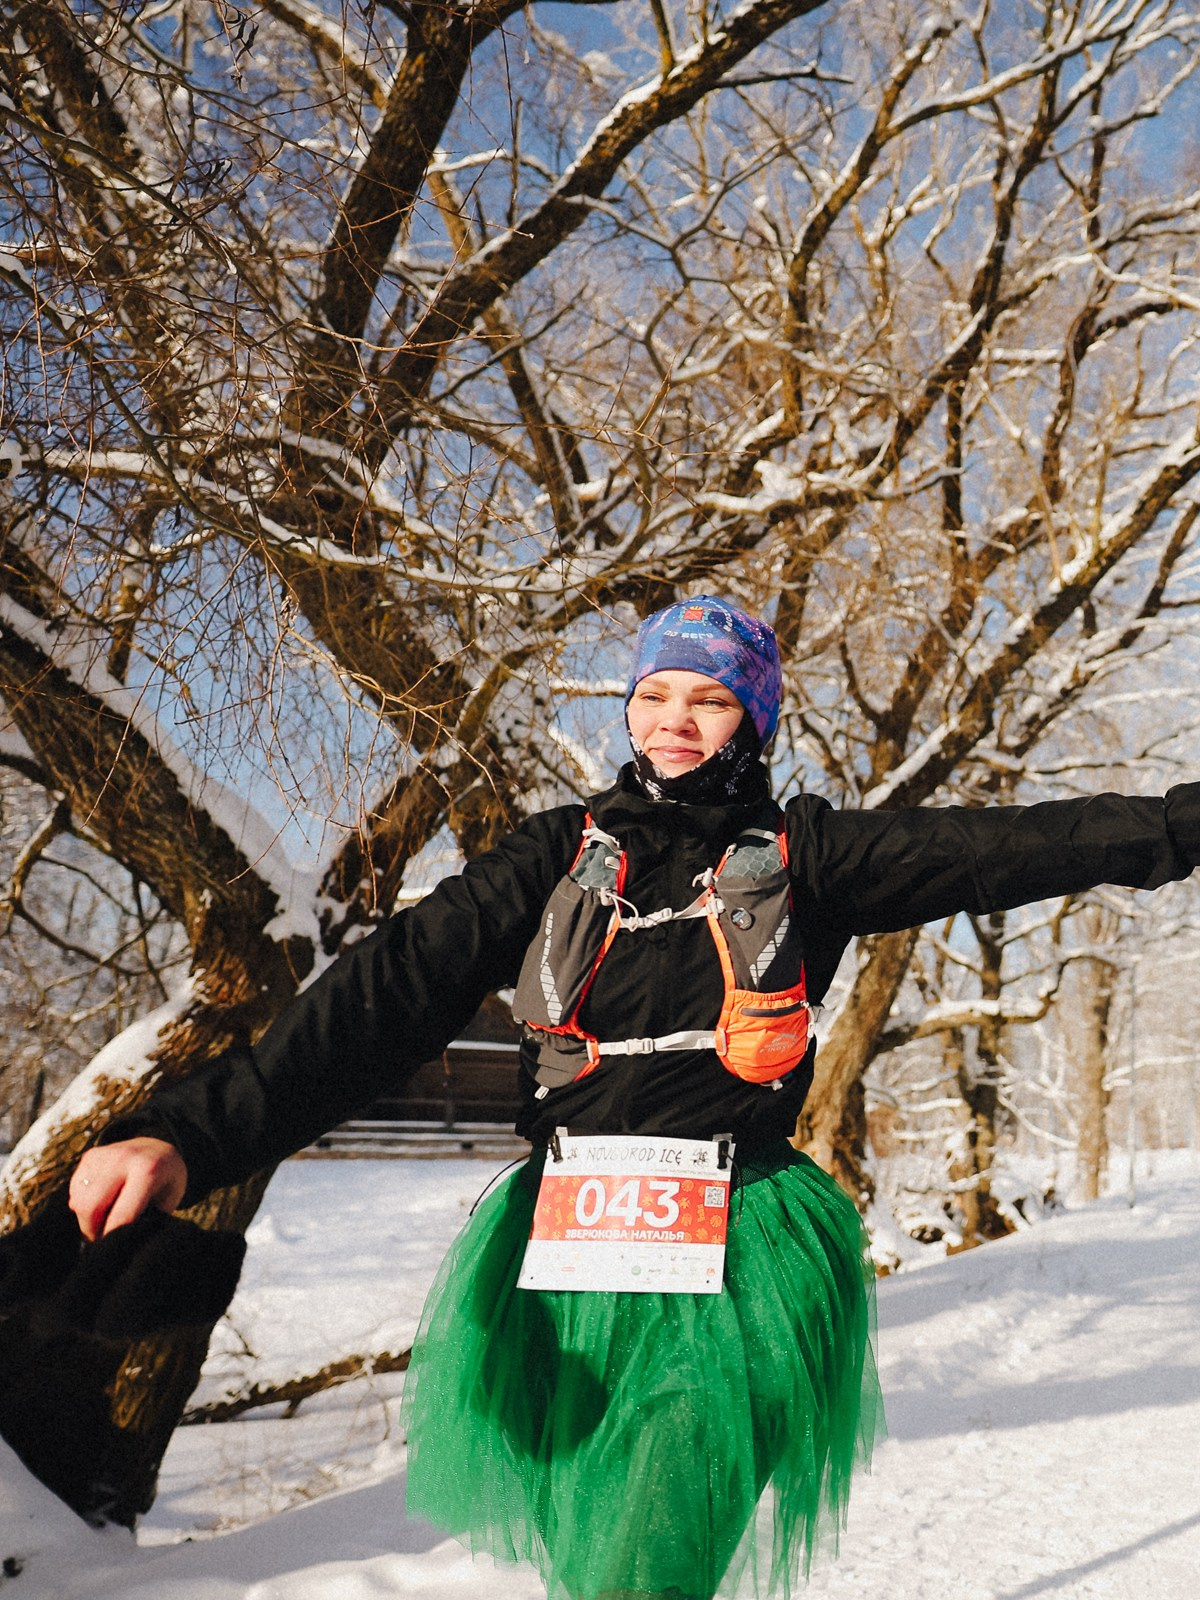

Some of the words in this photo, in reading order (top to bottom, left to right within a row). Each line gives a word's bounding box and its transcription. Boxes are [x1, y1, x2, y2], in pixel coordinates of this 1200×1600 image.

[587, 1147, 656, 1162] NOVGOROD
[659, 1149, 682, 1165] ICE
[575, 1179, 680, 1228] 043
[565, 1229, 628, 1240] ЗВЕРЮКОВА
[631, 1230, 685, 1241] НАТАЛЬЯ
